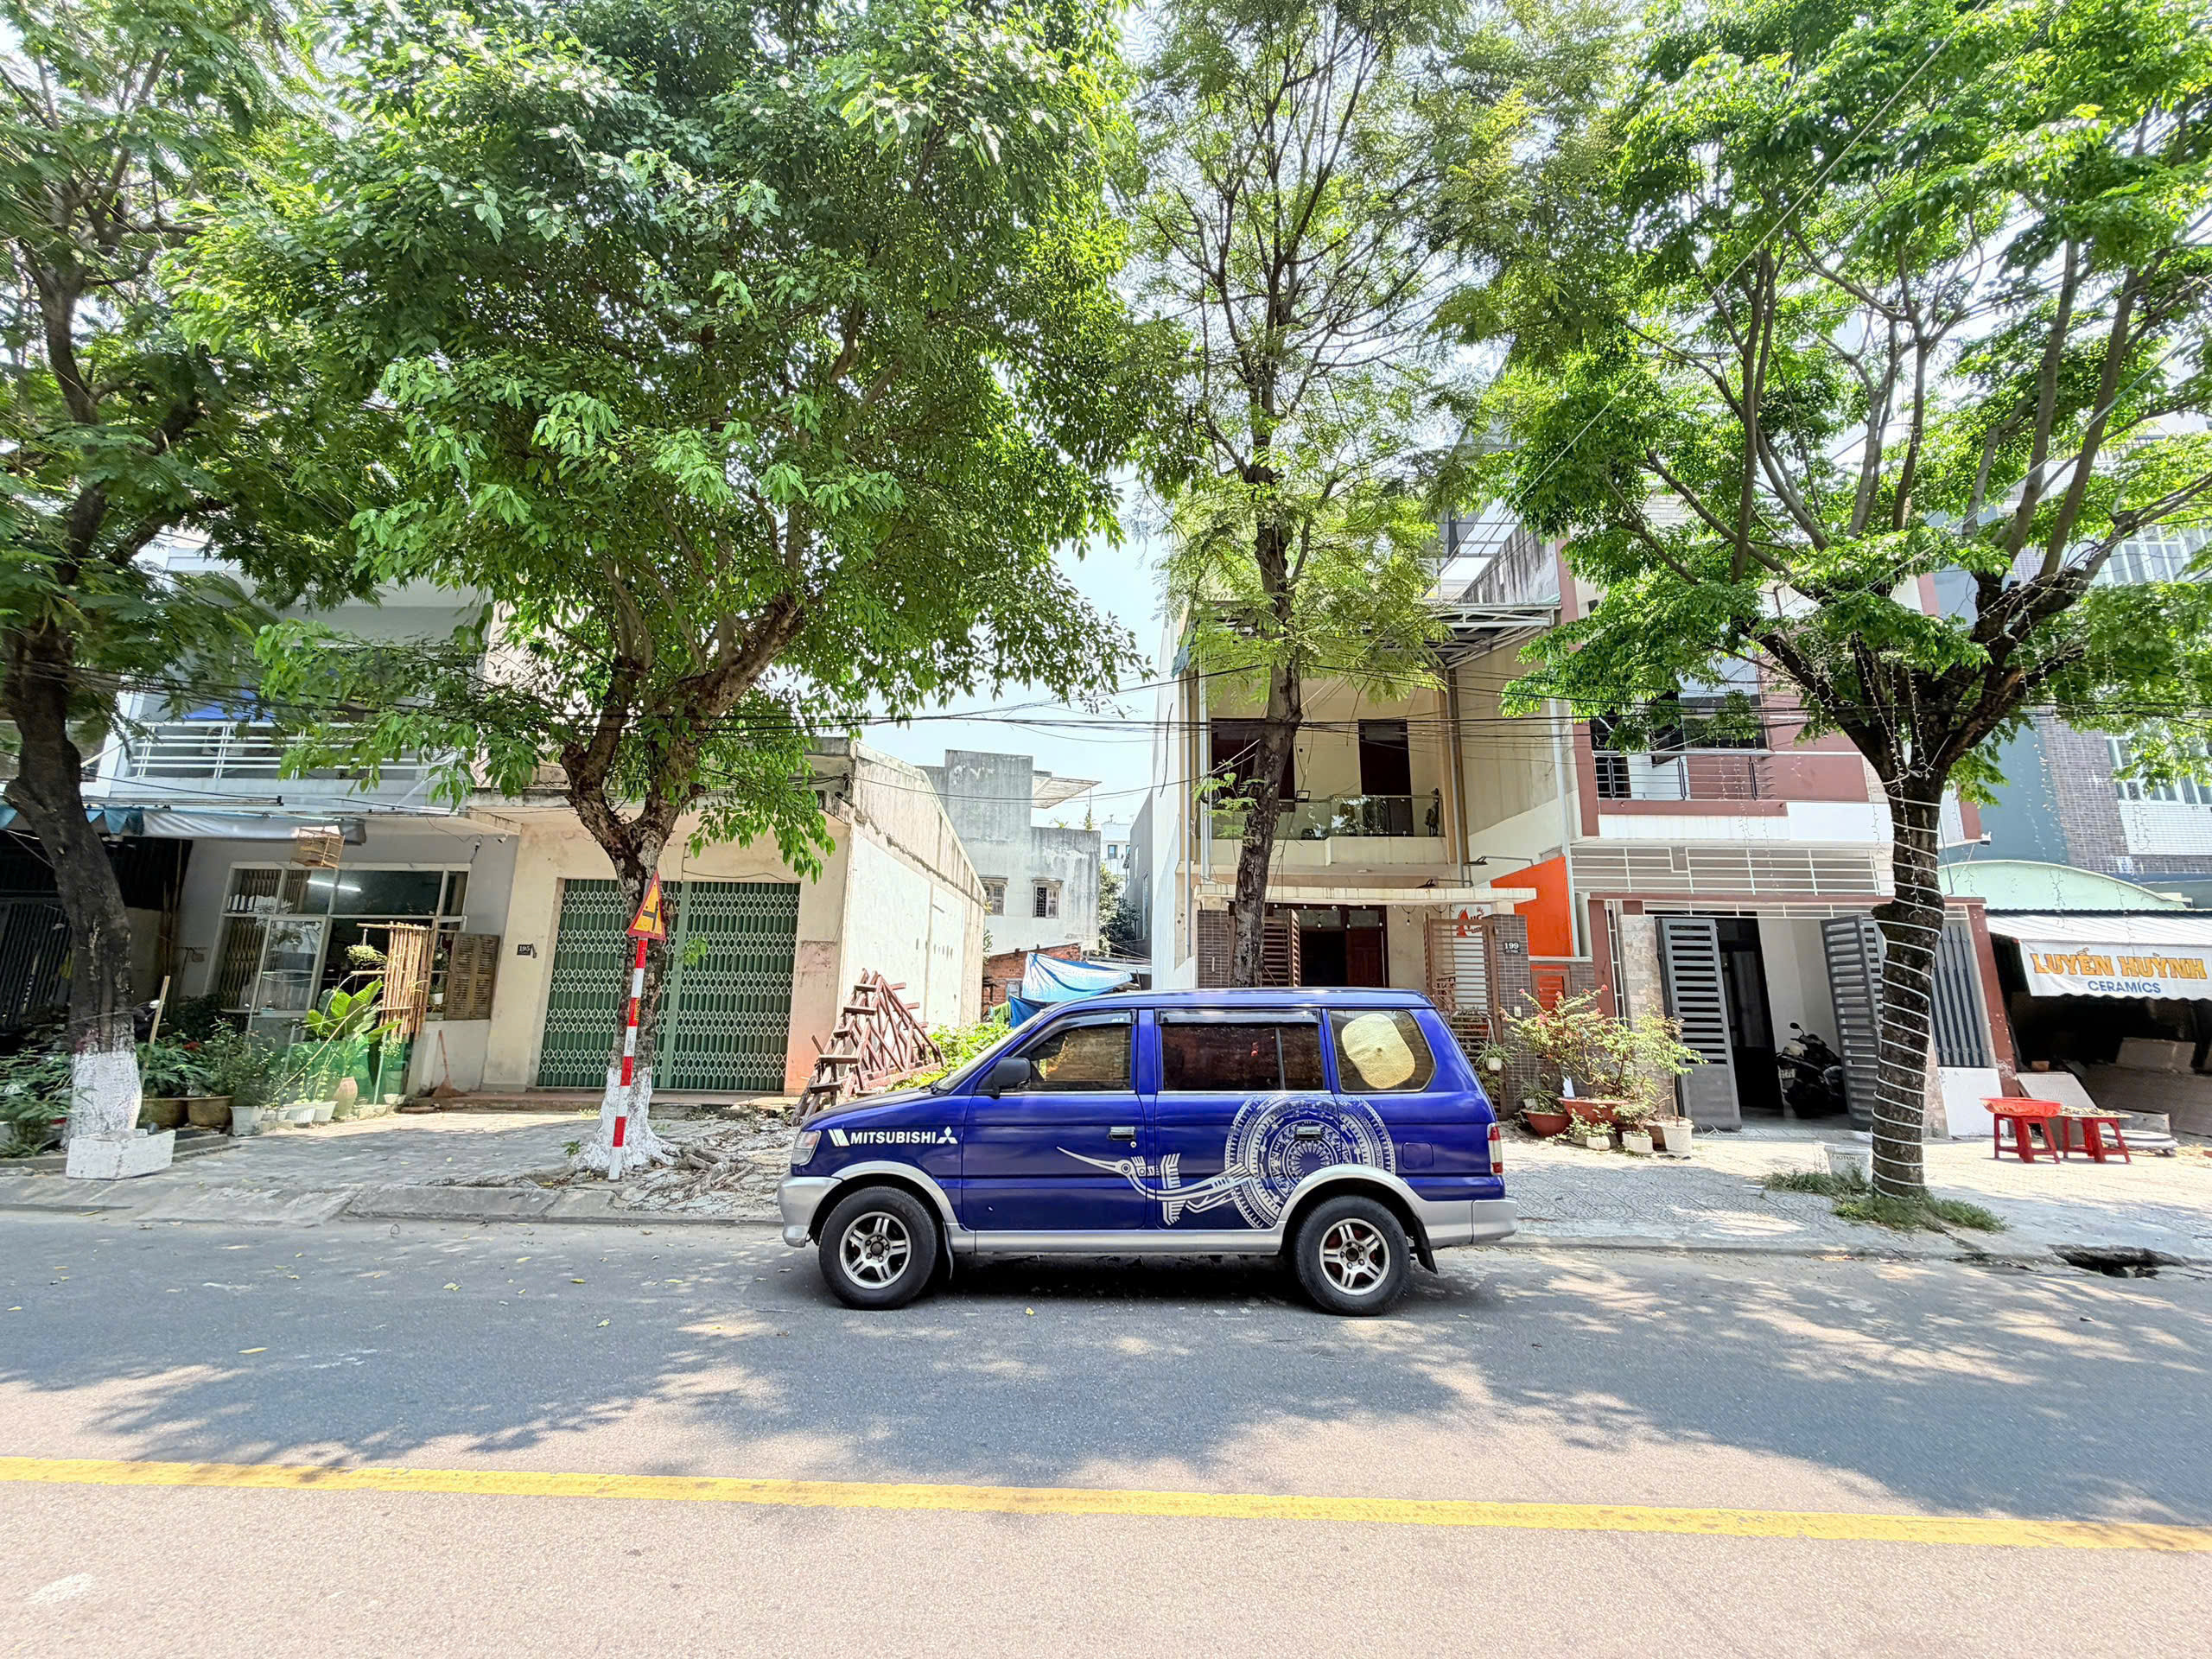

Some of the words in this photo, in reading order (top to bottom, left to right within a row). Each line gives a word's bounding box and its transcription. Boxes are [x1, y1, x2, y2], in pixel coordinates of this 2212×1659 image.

[2117, 952, 2208, 979] HUỲNH
[2088, 980, 2161, 994] CERAMICS
[850, 1131, 937, 1144] MITSUBISHI
